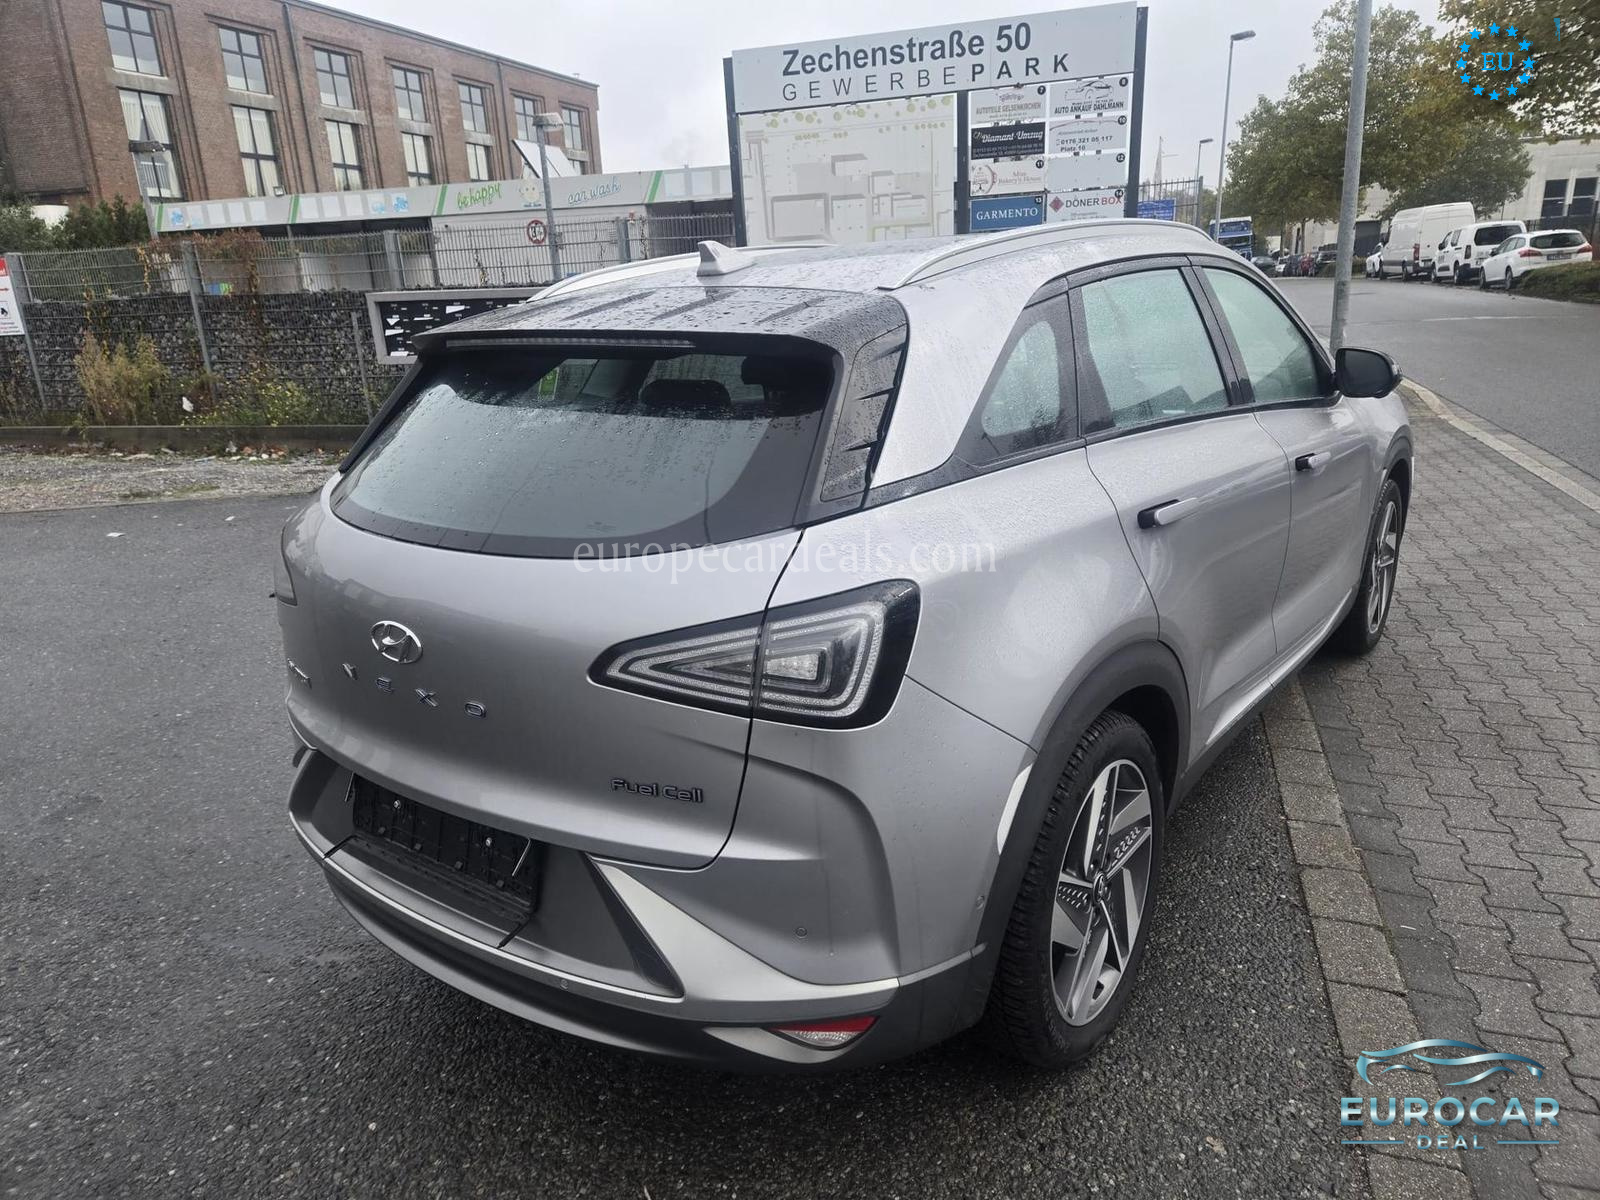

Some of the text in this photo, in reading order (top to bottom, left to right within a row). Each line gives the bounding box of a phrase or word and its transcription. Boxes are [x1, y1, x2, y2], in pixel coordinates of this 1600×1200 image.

[782, 22, 1031, 77] Zechenstraße 50
[782, 53, 1069, 101] GEWERBEPARK
[1054, 106, 1070, 114] AUTO
[1070, 104, 1092, 113] ANKAUF
[976, 207, 1038, 220] GARMENTO
[611, 779, 704, 803] Fuel Cell
